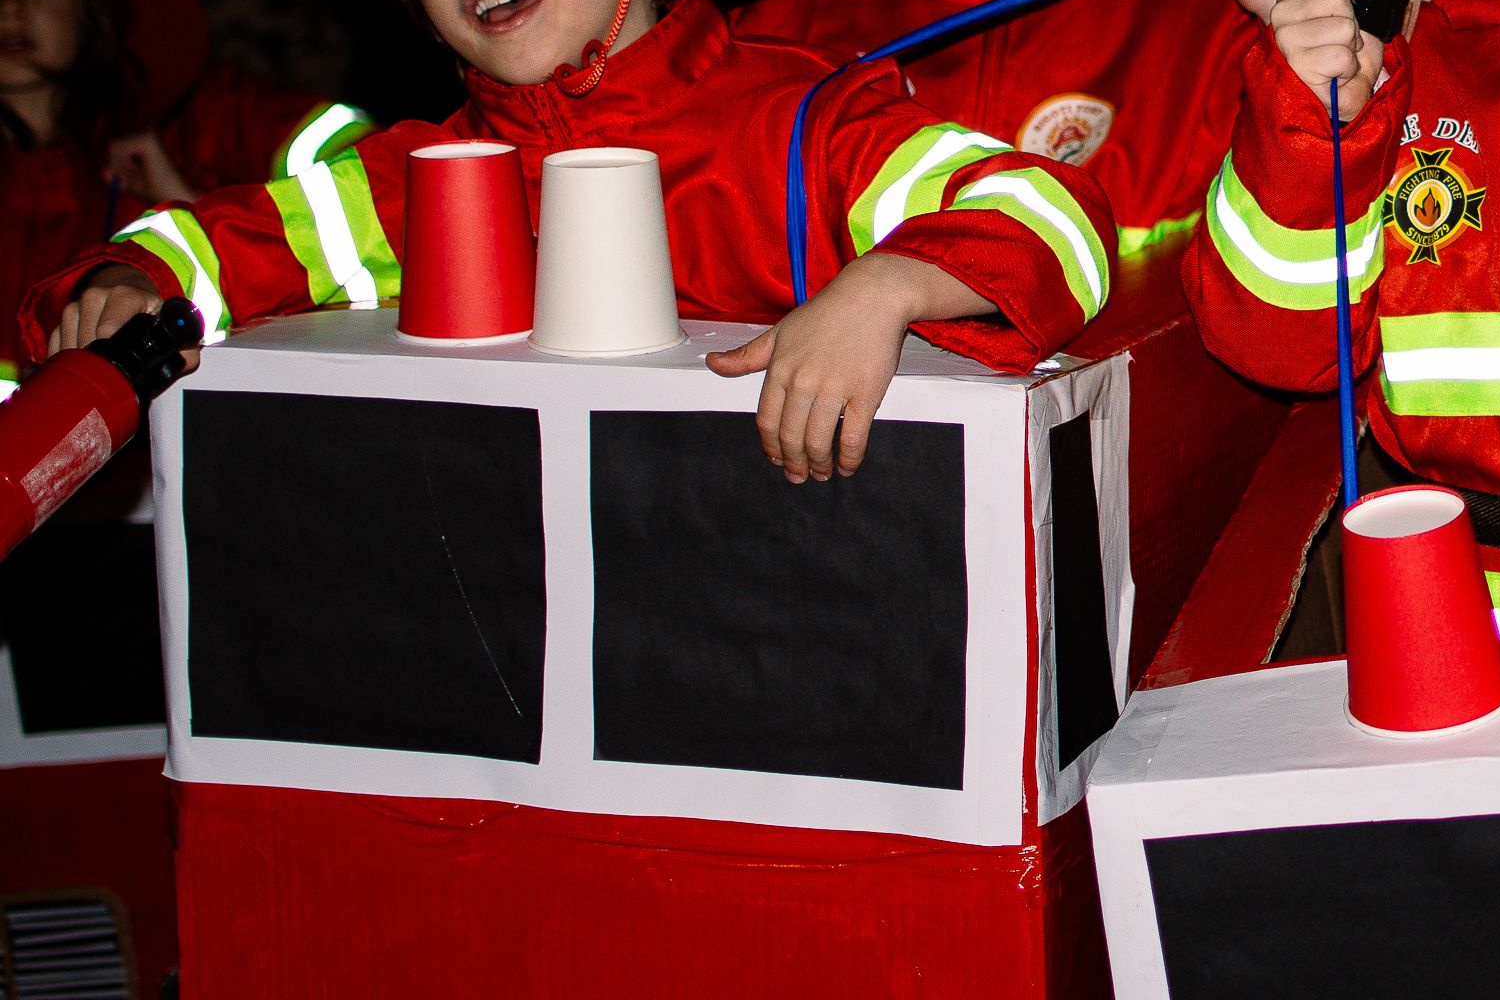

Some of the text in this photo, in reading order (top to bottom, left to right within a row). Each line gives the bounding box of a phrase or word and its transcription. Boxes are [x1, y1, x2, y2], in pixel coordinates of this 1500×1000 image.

[1398, 169, 1463, 201] FIGHTING FIRE
[1406, 227, 1432, 245] SINCE
